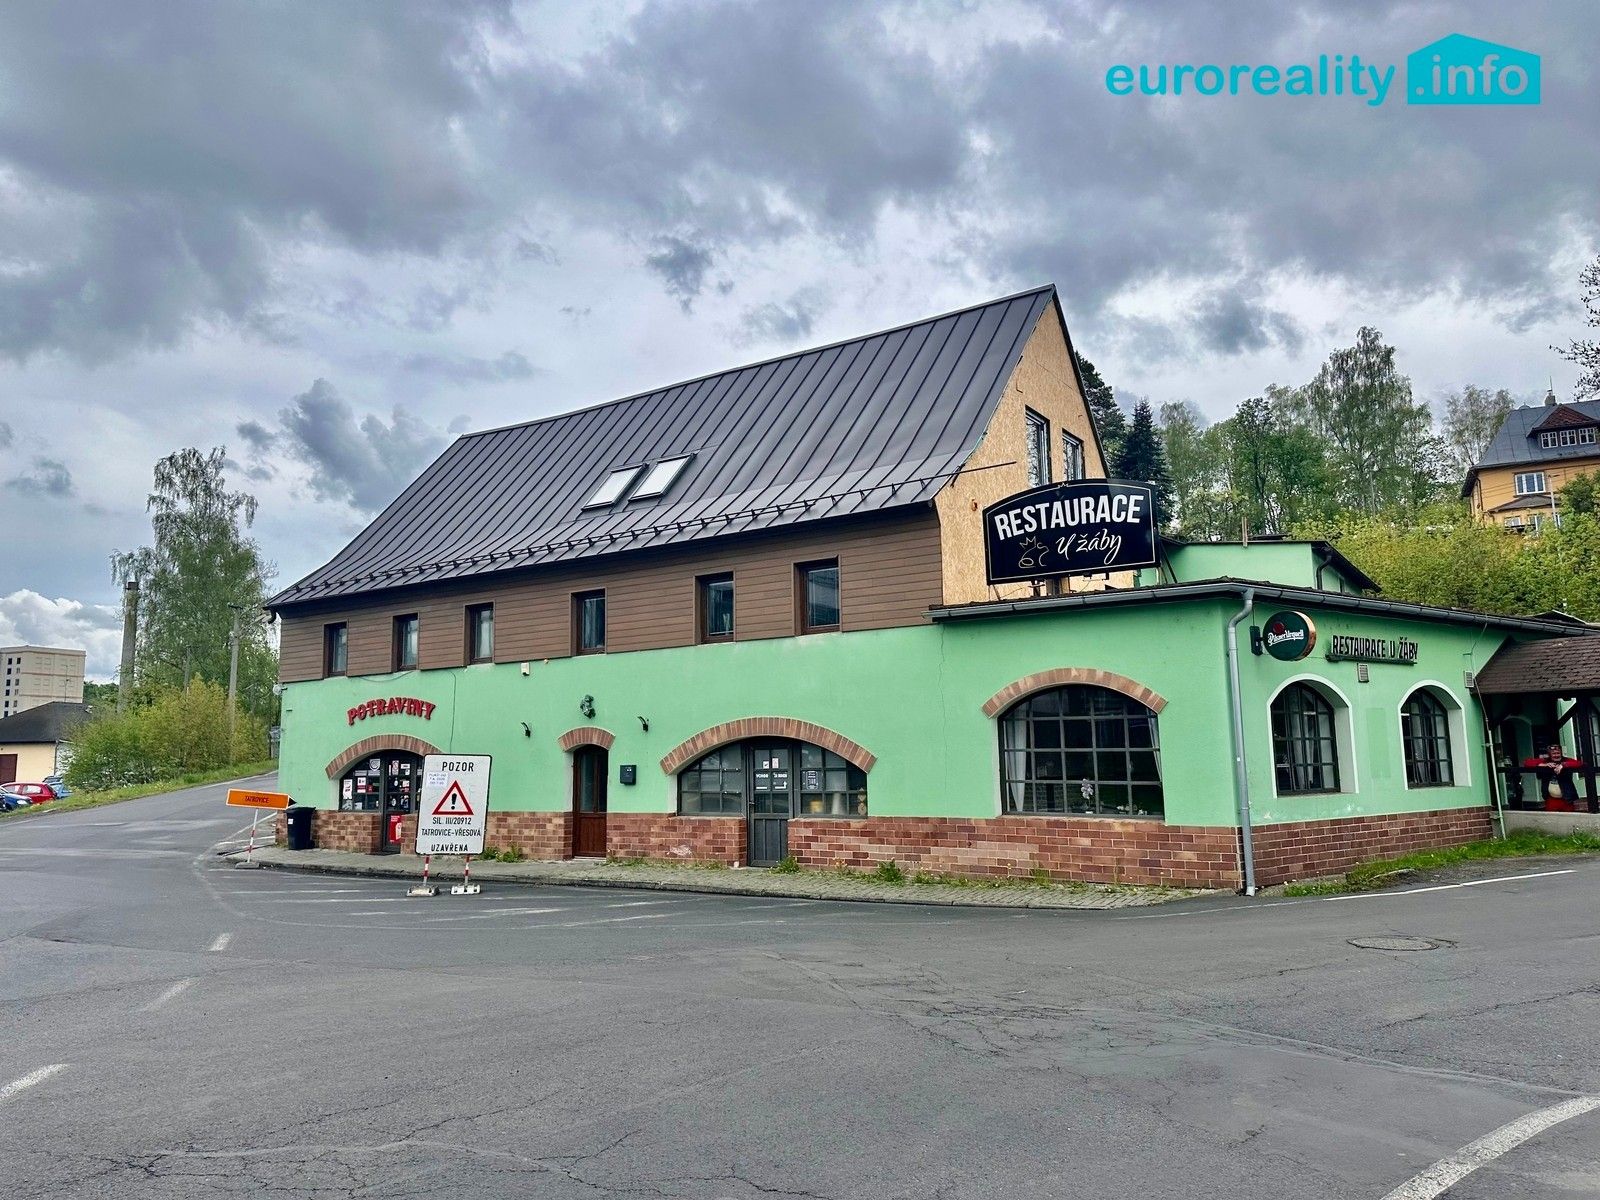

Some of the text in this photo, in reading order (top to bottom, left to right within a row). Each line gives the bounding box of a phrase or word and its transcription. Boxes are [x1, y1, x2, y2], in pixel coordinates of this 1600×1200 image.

[994, 494, 1144, 540] RESTAURACE
[1076, 528, 1122, 566] žáby
[1332, 635, 1418, 660] RESTAURACE U ŽÁBY
[347, 697, 436, 726] POTRAVINY
[442, 761, 475, 772] POZOR
[430, 843, 468, 852] UZAVŘENA
